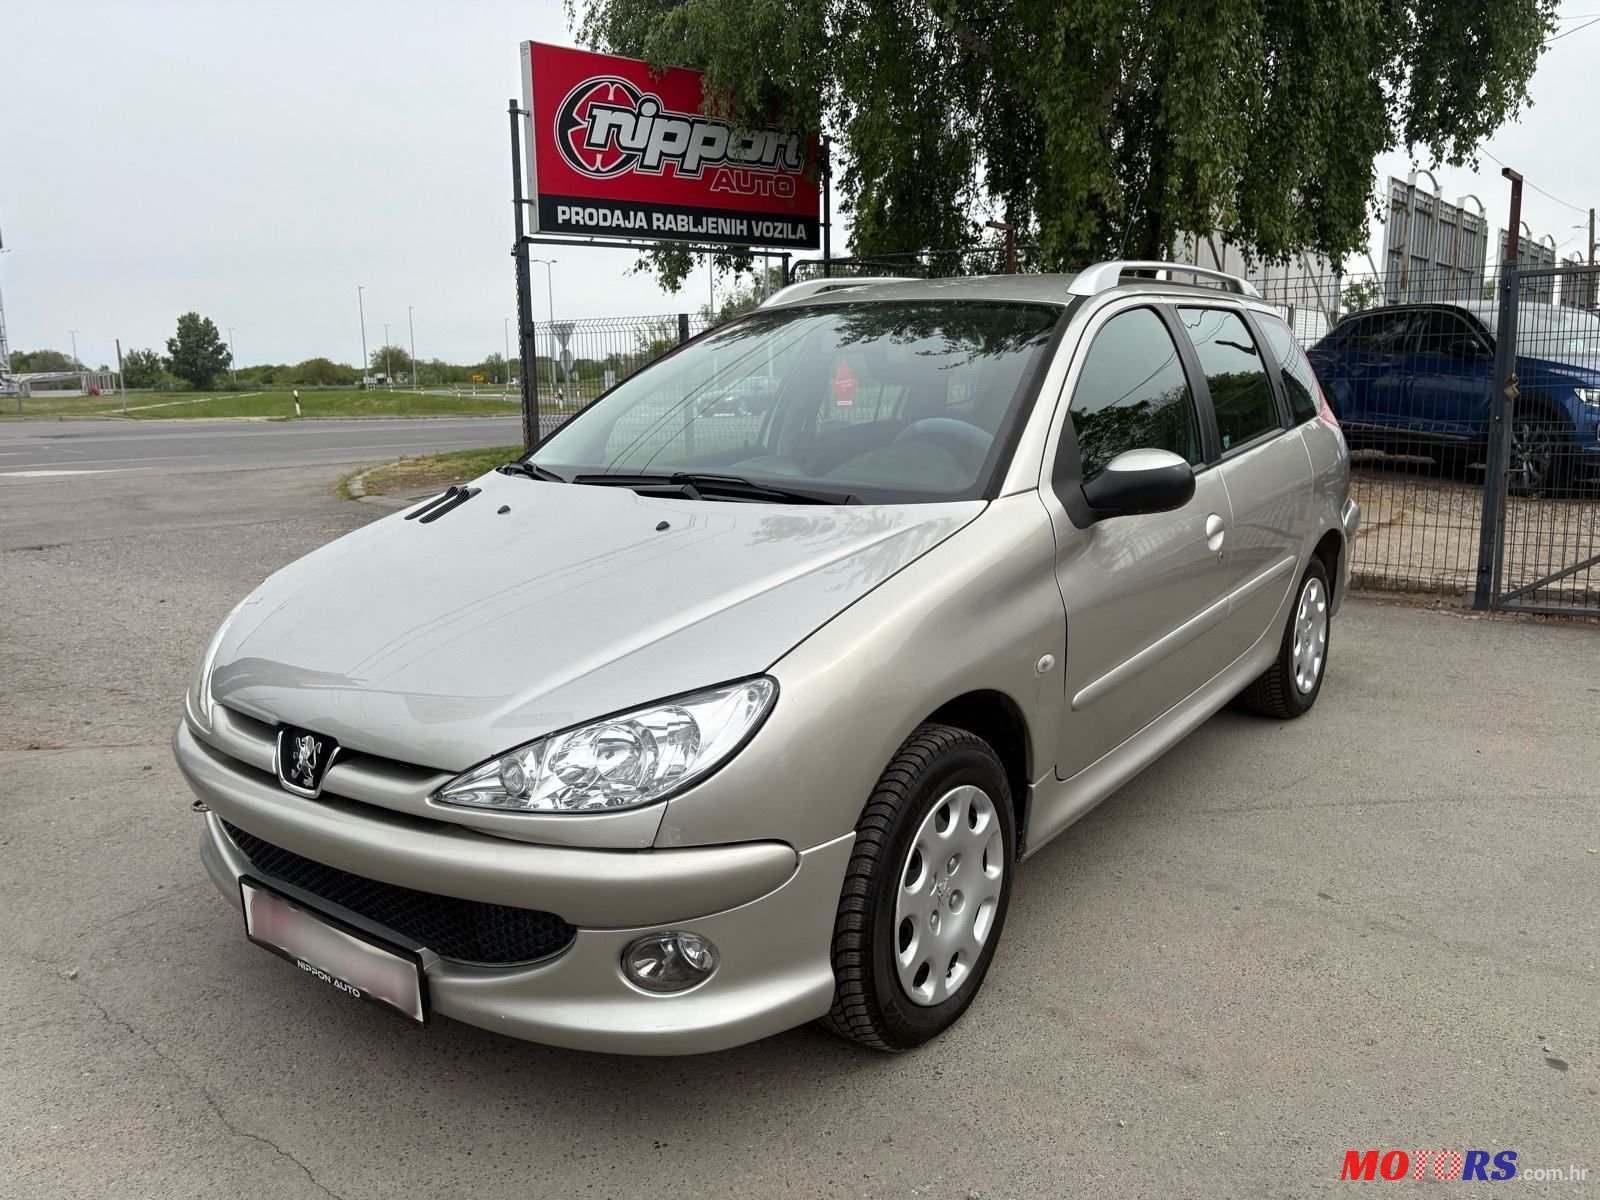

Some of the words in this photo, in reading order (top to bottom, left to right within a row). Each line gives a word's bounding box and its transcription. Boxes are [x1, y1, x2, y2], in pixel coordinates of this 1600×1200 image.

[586, 97, 804, 175] nippon
[709, 168, 796, 198] AUTO
[556, 205, 649, 230] PRODAJA
[652, 212, 748, 236] RABLJENIH
[751, 220, 807, 241] VOZILA
[297, 959, 331, 984] NIPPON
[333, 979, 361, 998] AUTO
